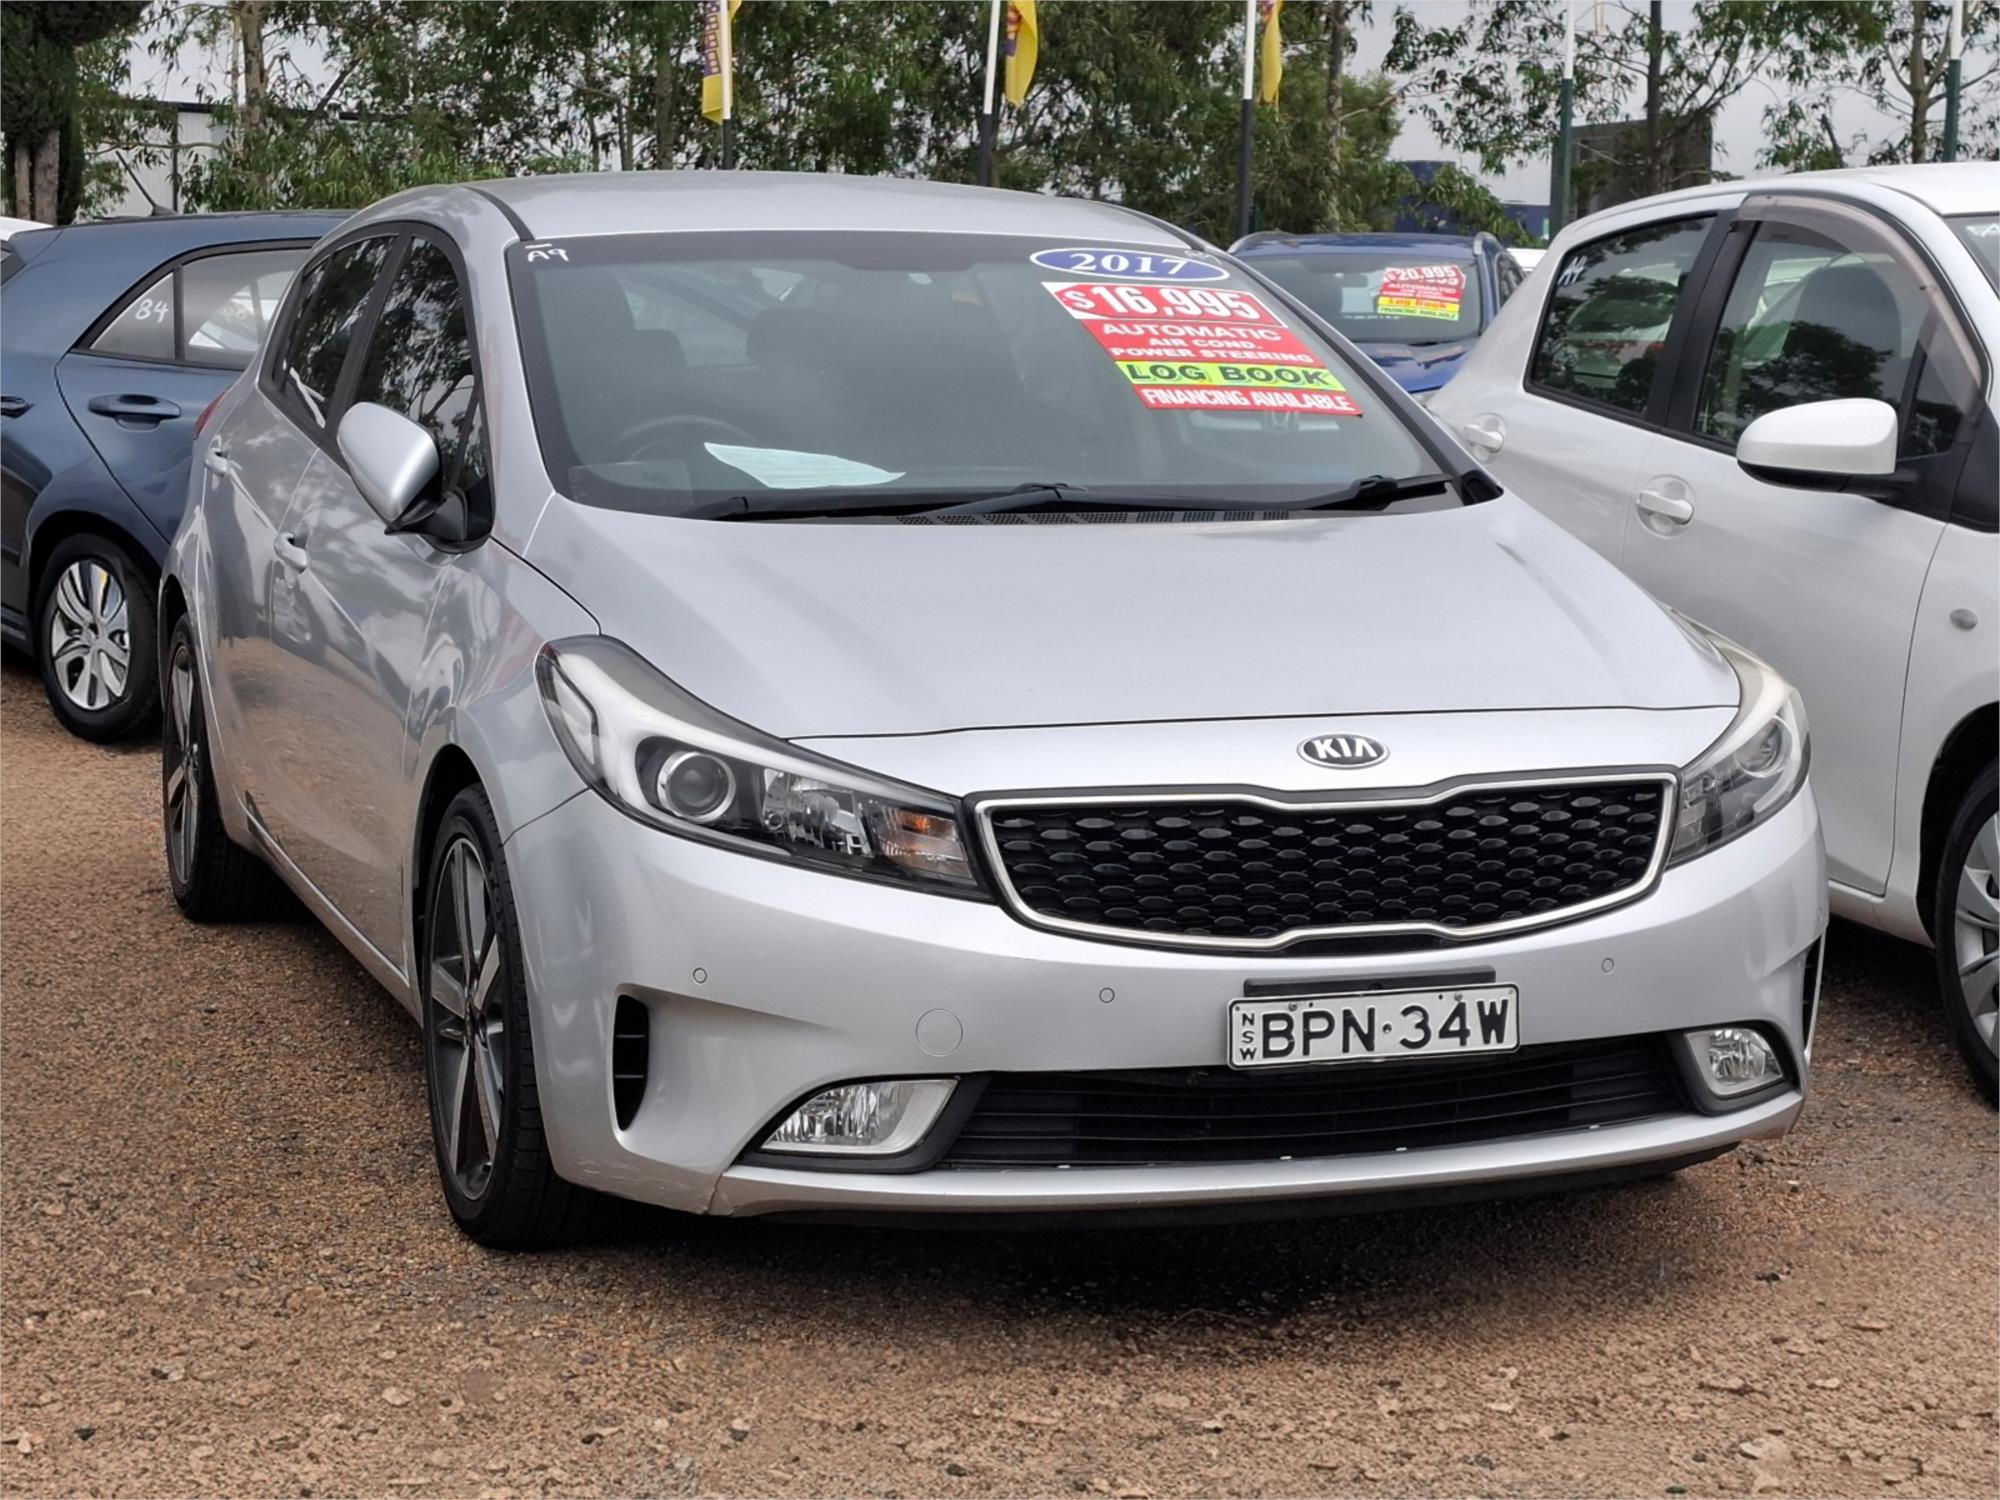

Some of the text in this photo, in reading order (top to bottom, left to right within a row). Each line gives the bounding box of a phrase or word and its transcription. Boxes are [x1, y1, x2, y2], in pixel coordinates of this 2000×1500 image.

[1069, 252, 1188, 275] 2017
[135, 298, 169, 323] 84
[1063, 286, 1261, 320] $16,995
[1103, 323, 1283, 341] AUTOMATIC
[1149, 338, 1188, 347] AIR
[1109, 347, 1314, 363] POWER STEERING
[1127, 364, 1330, 386] LOG BOOK
[1141, 389, 1355, 411] FINANCING AVAILABLE
[1312, 738, 1378, 759] KIA
